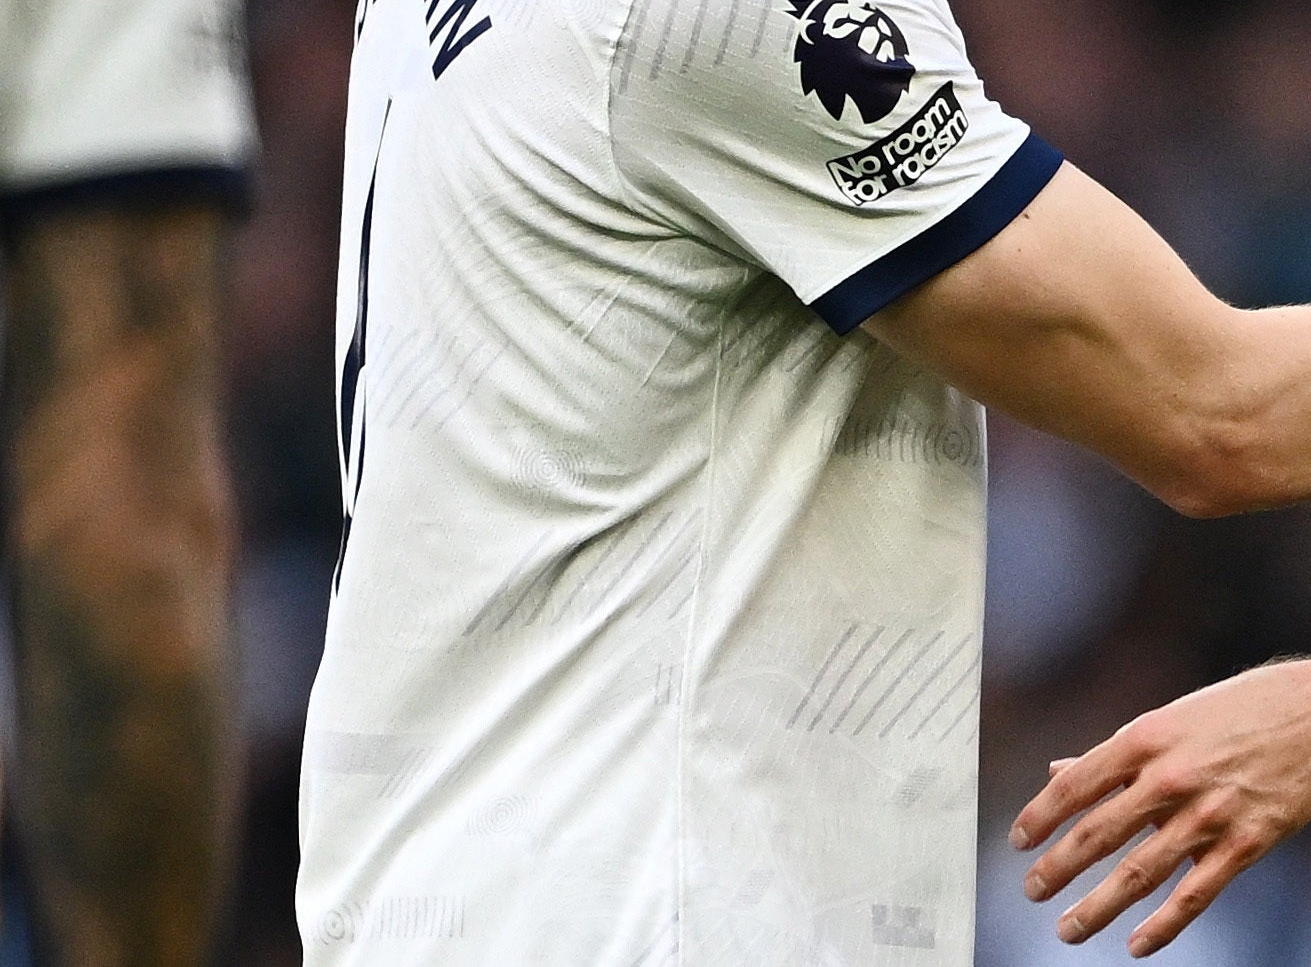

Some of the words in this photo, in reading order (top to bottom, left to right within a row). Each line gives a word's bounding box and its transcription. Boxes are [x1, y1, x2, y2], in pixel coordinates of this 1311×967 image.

[829, 154, 882, 186] No
[881, 96, 951, 166] room
[840, 172, 888, 205] for
[892, 108, 968, 186] racism
